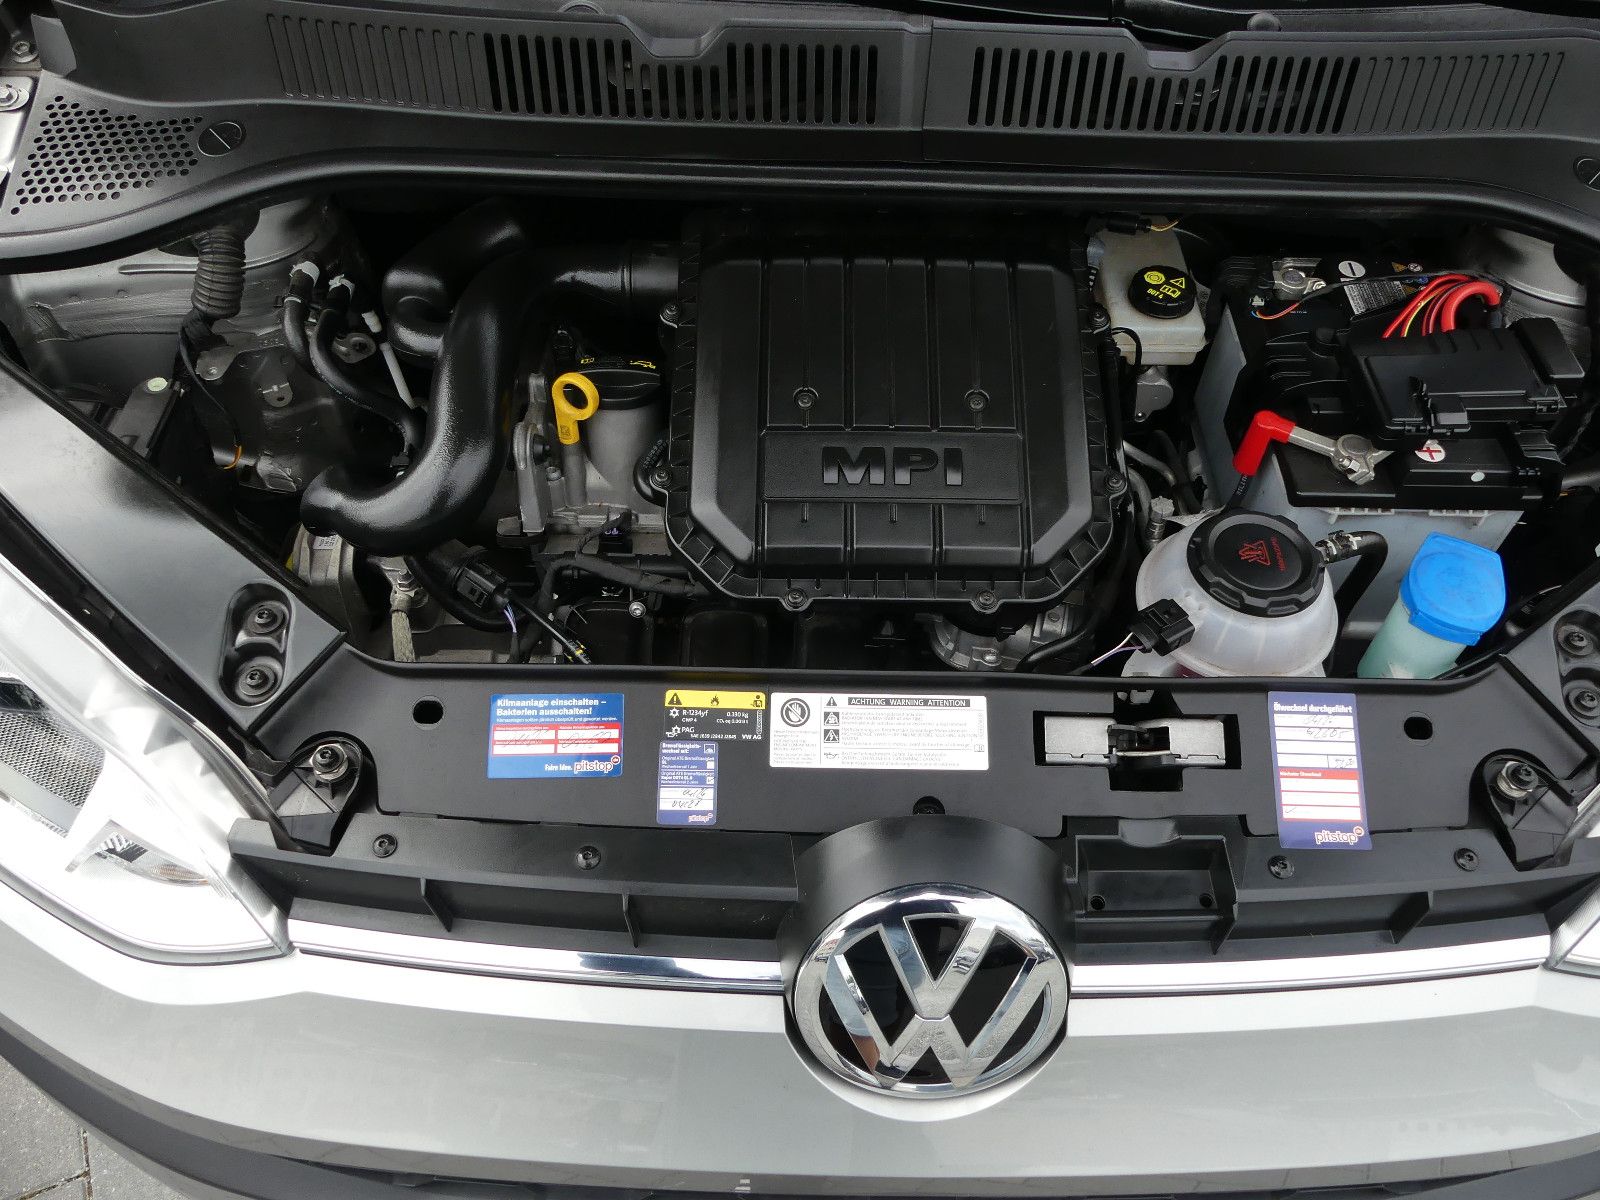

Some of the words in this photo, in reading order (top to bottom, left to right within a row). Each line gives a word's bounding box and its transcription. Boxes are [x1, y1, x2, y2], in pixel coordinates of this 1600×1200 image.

[822, 446, 963, 486] MPI
[496, 698, 549, 708] Klimaanlage
[551, 698, 599, 706] einschalten
[851, 698, 886, 706] ACHTUNG
[889, 698, 924, 707] WARNING
[927, 699, 966, 707] ATTENTION
[496, 708, 538, 717] Bakterien
[539, 707, 592, 716] ausschalten!
[682, 709, 708, 717] R-1234yf
[1308, 703, 1353, 715] durchgeführt
[574, 760, 613, 774] pitstop
[1315, 829, 1358, 845] pitstop
[815, 900, 1055, 1091] VW
